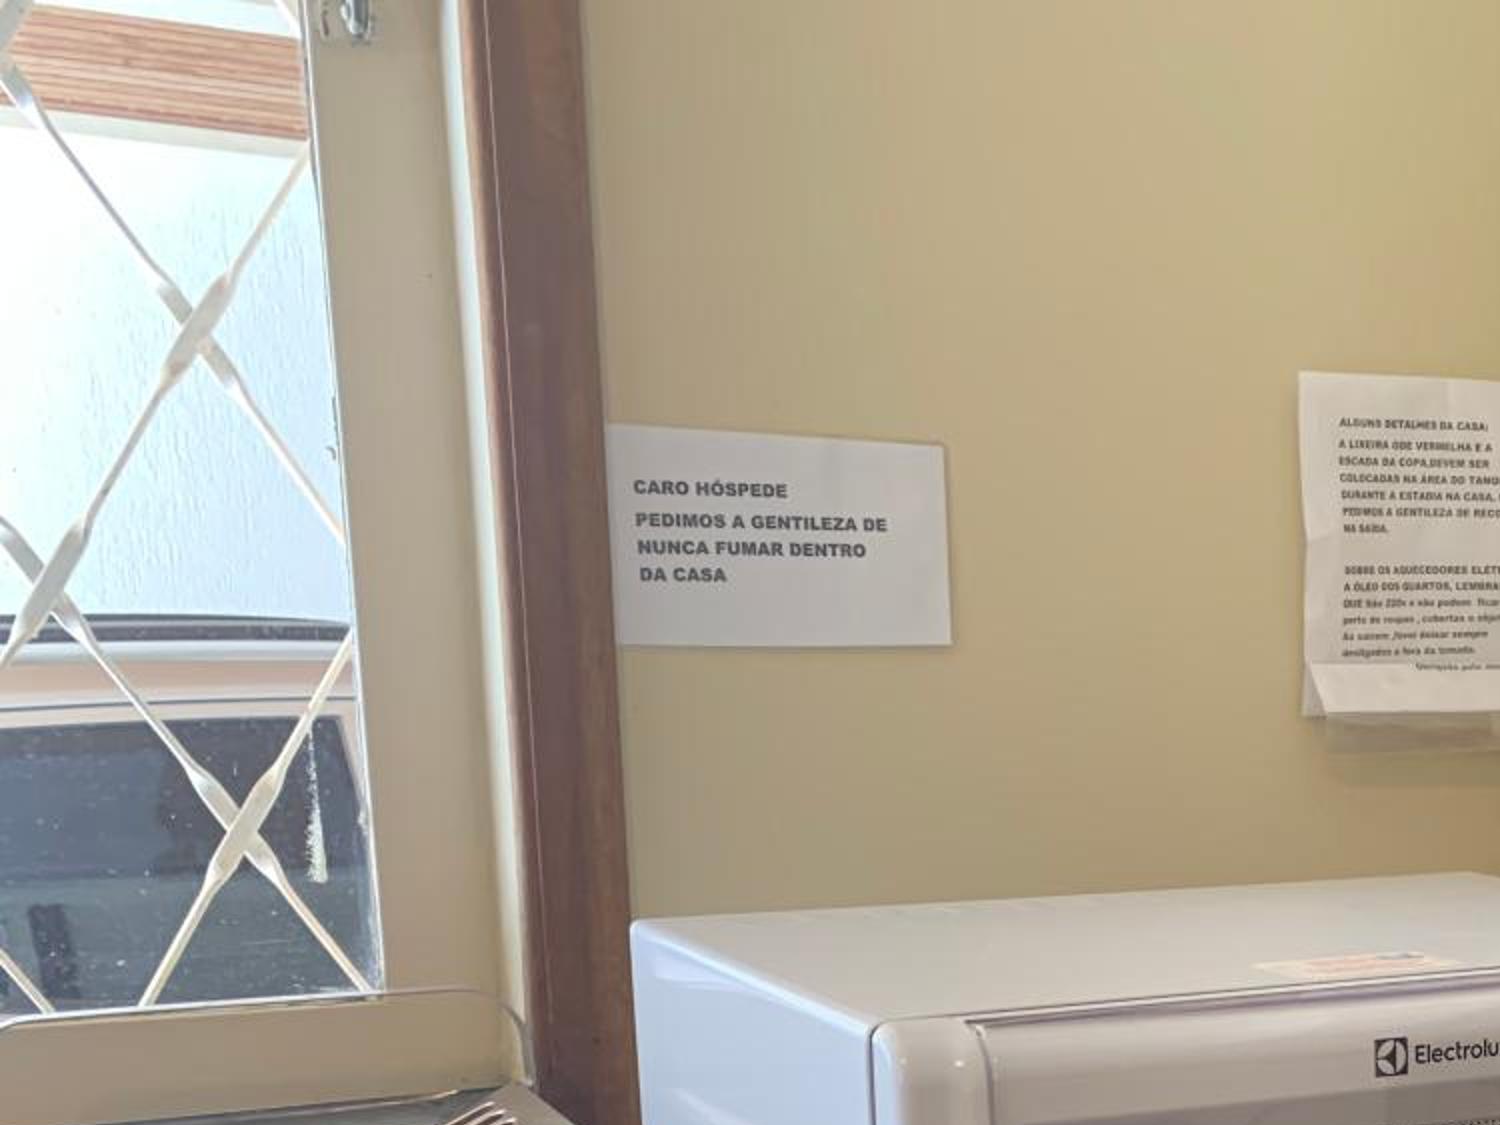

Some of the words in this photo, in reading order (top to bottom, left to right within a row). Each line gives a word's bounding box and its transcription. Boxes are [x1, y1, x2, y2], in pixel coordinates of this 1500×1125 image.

[1339, 418, 1382, 428] ALGUNS
[1384, 420, 1437, 430] DETALHES
[1440, 421, 1453, 430] DA
[1339, 440, 1346, 448] A
[1349, 440, 1389, 450] LIXEIRA
[1416, 441, 1472, 452] VERMELHA
[1476, 443, 1481, 452] E
[1485, 443, 1492, 452] A
[1338, 456, 1378, 466] ESCADA
[1382, 458, 1396, 467] DA
[1469, 460, 1490, 469] SER
[1340, 474, 1400, 483] COLOCADAS
[1403, 475, 1417, 484] NA
[1450, 476, 1466, 485] DO
[633, 479, 690, 496] CARO
[696, 480, 788, 499] HÓSPEDE
[1341, 490, 1385, 500] DURANTE
[1389, 491, 1396, 500] A
[1400, 492, 1442, 500] ESTADIA
[1446, 492, 1460, 501] NA
[1342, 508, 1383, 516] PEDIMOS
[1386, 508, 1392, 516] A
[1396, 508, 1453, 518] GENTILEZA
[1456, 508, 1470, 518] DE
[635, 512, 726, 529] PEDIMOS
[732, 515, 745, 529] A
[751, 515, 857, 532] GENTILEZA
[863, 518, 888, 533] DE
[1344, 524, 1356, 532] NA
[637, 540, 709, 556] NUNCA
[716, 541, 784, 557] FUMAR
[790, 542, 867, 558] DENTRO
[640, 567, 667, 583] DA
[673, 567, 727, 583] CASA
[1344, 566, 1376, 575] SOBRE
[1378, 566, 1390, 574] OS
[1393, 565, 1468, 575] AQUECEDORES
[1344, 582, 1350, 591] A
[1382, 582, 1400, 591] DOS
[1344, 599, 1362, 608] QUE
